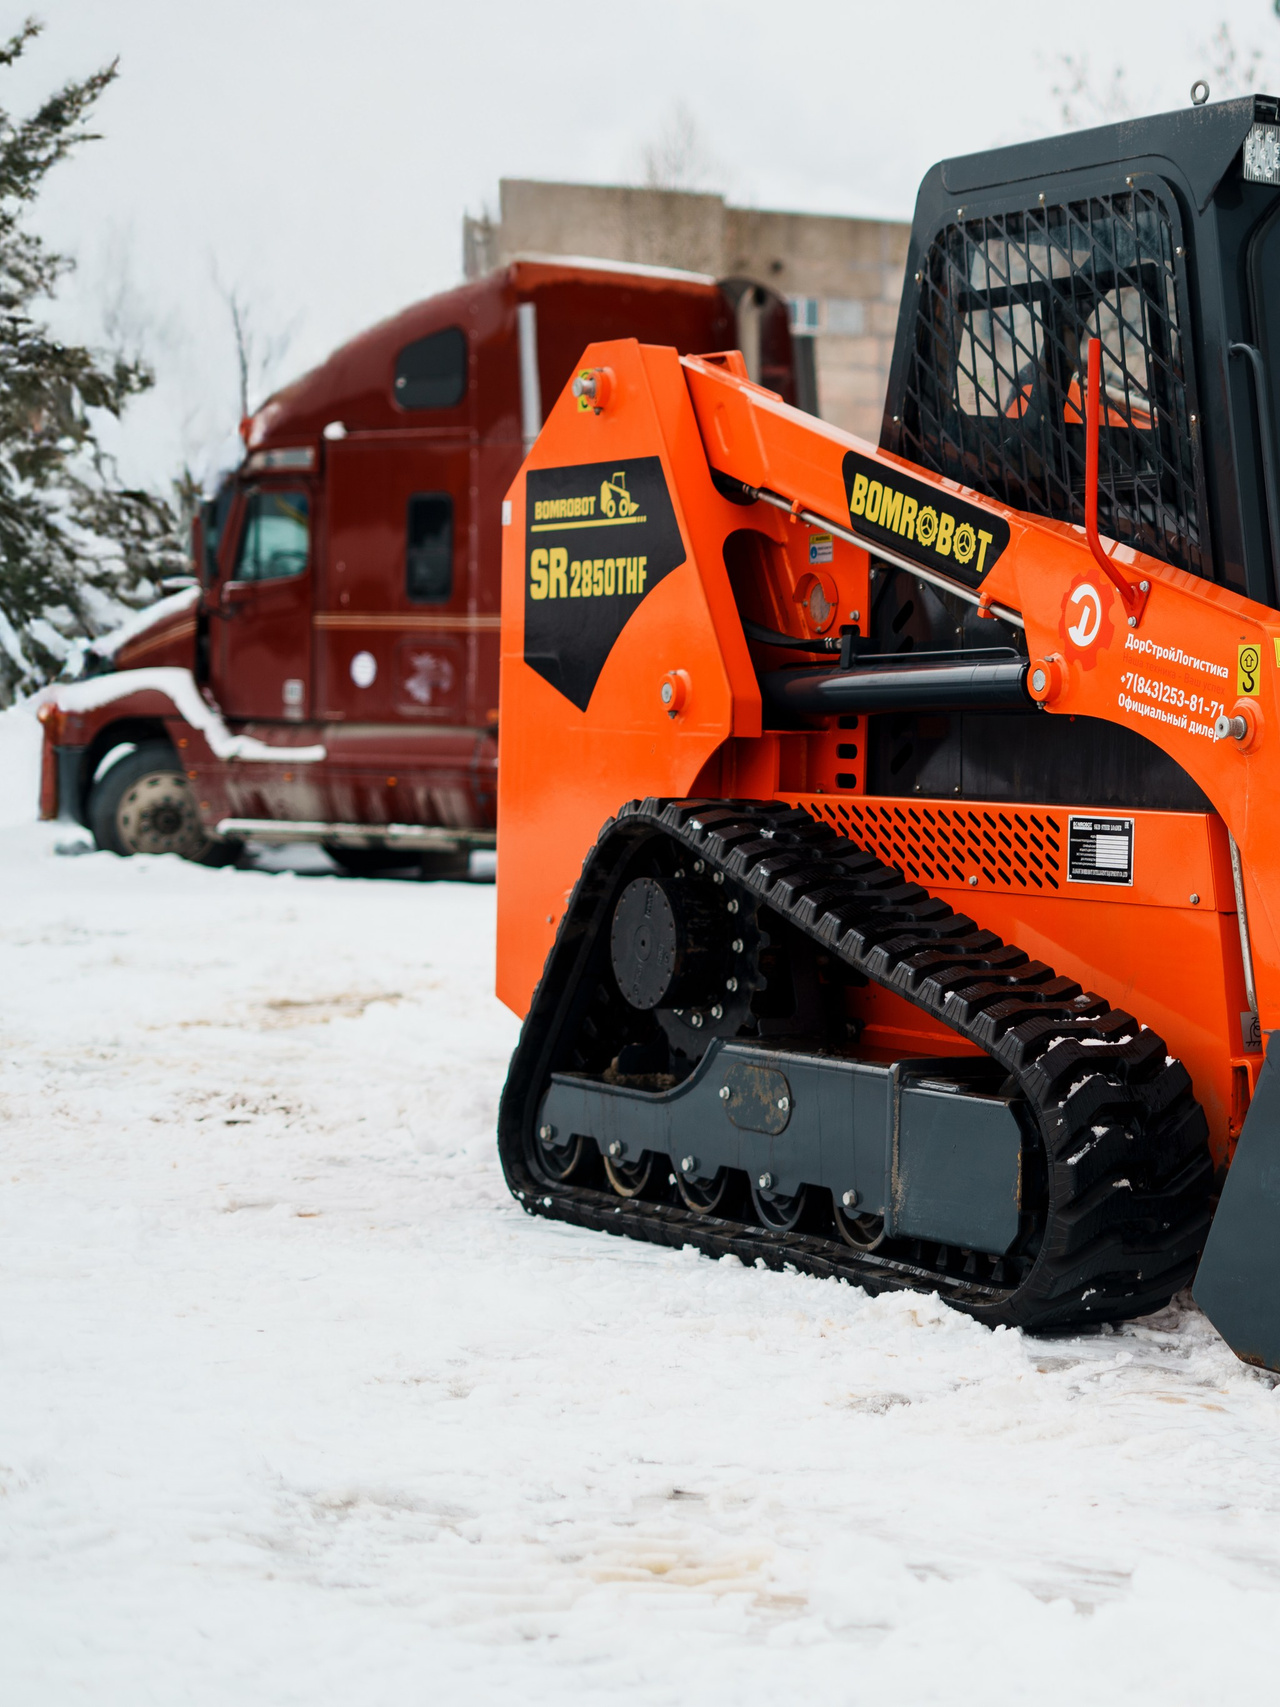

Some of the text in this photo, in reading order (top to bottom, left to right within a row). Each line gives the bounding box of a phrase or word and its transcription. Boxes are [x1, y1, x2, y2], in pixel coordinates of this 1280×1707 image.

[534, 496, 596, 520] BOMROBOT
[850, 472, 993, 573] BOMROBOT
[530, 547, 647, 600] SR 2850THF
[1122, 652, 1144, 665] Наша
[1146, 662, 1176, 679] техника
[1184, 672, 1201, 688] Ваш
[1203, 681, 1225, 696] успех
[1124, 633, 1229, 679] ДорСтройЛогистика
[1118, 693, 1188, 729] Официальный
[1120, 672, 1225, 718] +7(843)253-81-71
